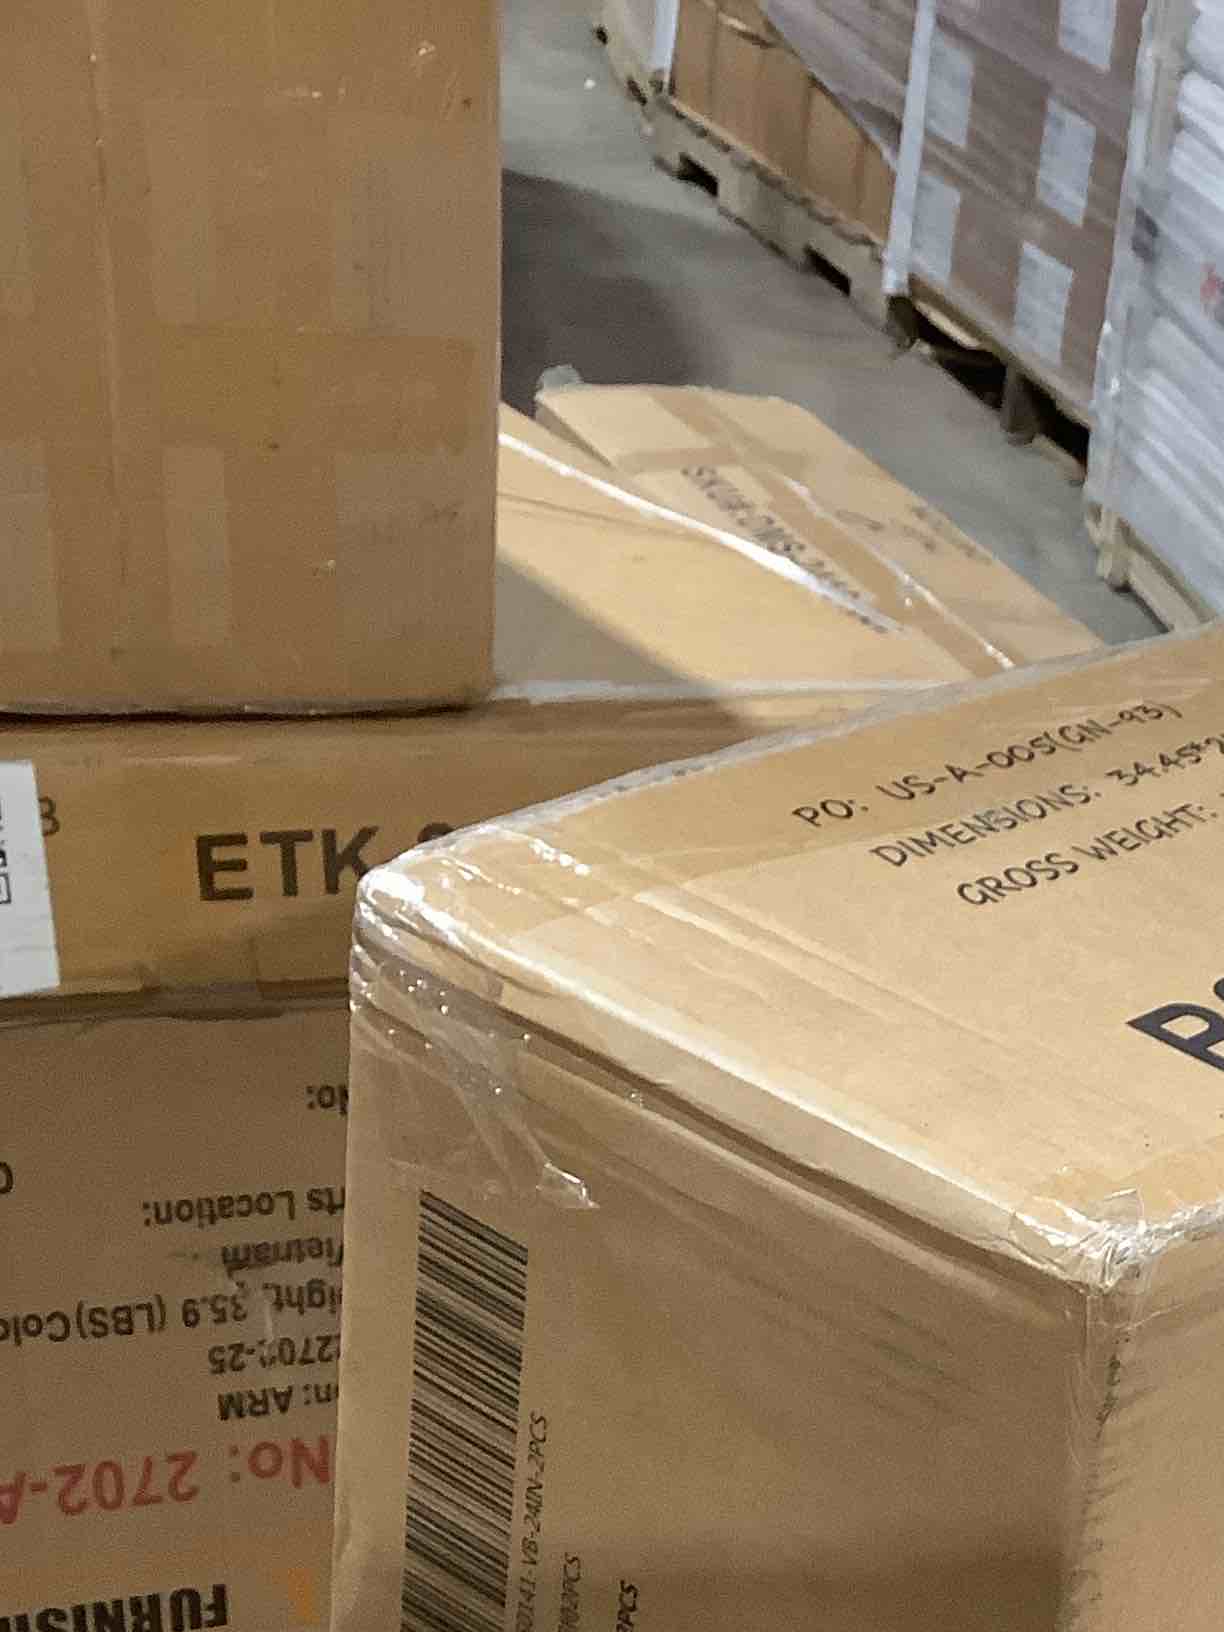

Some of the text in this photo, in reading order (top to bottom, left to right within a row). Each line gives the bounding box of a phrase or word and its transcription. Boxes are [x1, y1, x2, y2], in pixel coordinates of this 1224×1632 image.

[792, 797, 870, 828] PO:
[870, 783, 1102, 868] DIMENSIONS:
[195, 824, 379, 901] ETK
[957, 852, 1080, 909] GROSS
[1072, 803, 1219, 863] WEIGHT:
[142, 1189, 296, 1229] Location:
[216, 1383, 340, 1421] n: ARM
[228, 1434, 336, 1488] No:
